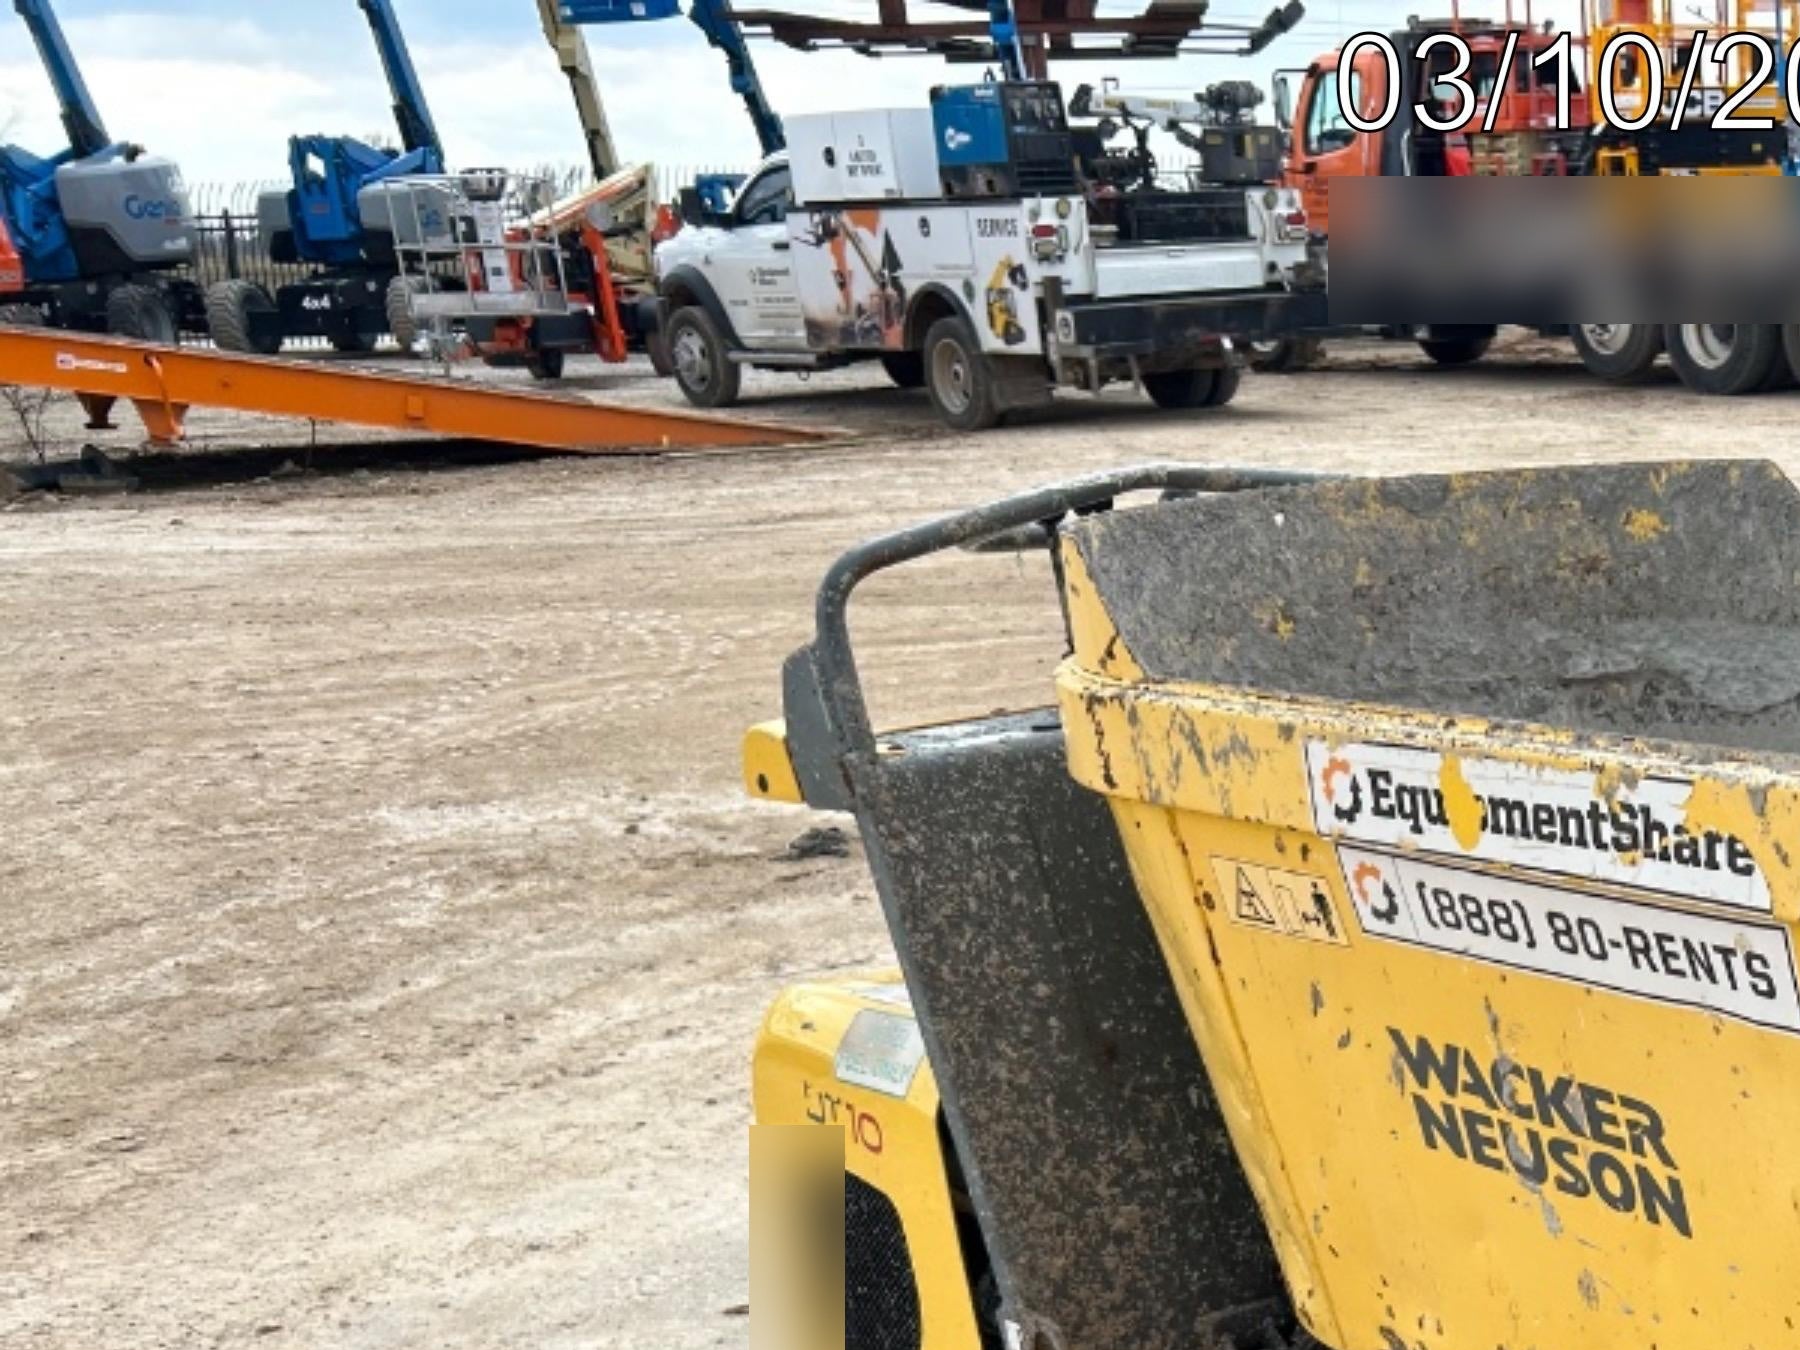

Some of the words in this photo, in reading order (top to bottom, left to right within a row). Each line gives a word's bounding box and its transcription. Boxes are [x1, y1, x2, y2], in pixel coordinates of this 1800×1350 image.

[976, 217, 1018, 238] SERVICE
[1366, 768, 1755, 878] EqumentShare
[1416, 881, 1537, 949] (888)
[1547, 911, 1778, 1001] 80-RENTS
[1385, 1025, 1679, 1171] WACKER
[1411, 1092, 1693, 1240] NEUSON
